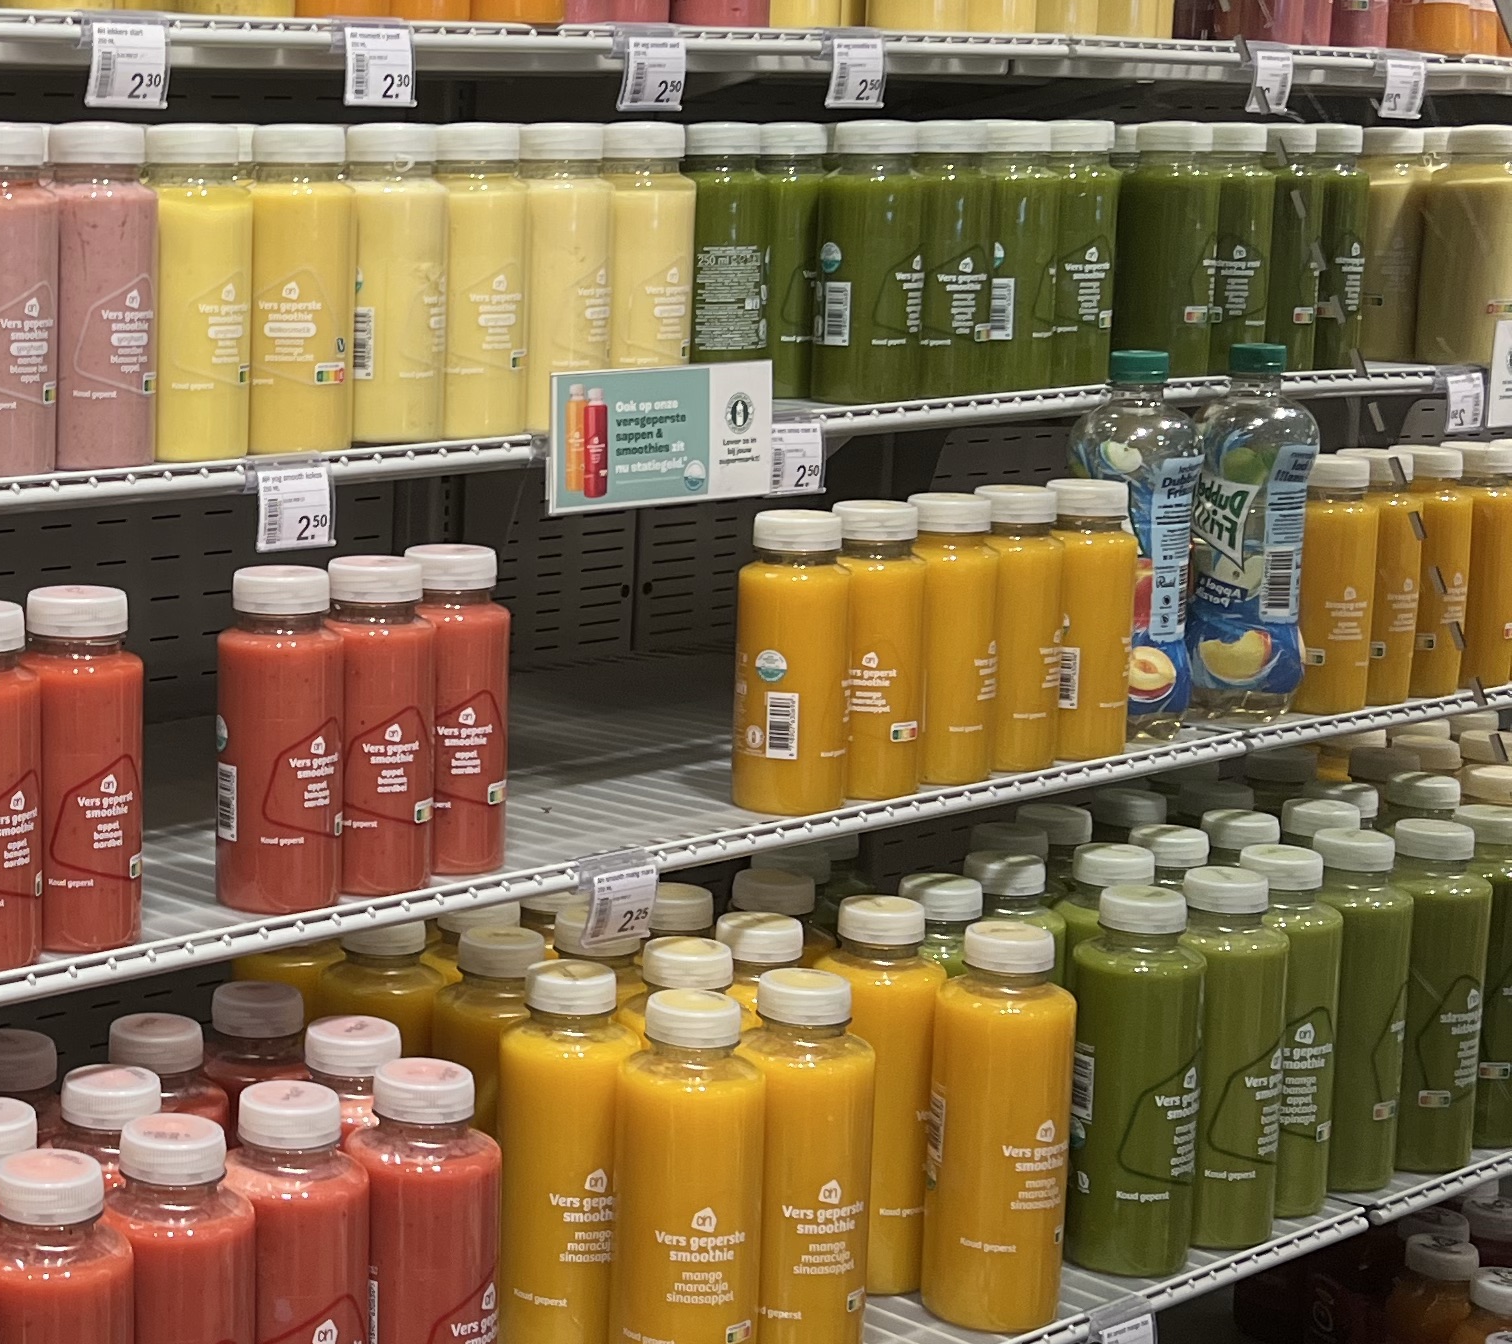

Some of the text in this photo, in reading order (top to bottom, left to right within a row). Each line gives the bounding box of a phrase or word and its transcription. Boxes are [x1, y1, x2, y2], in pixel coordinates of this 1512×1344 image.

[127, 72, 161, 99] 2.30
[382, 74, 410, 99] 2.30
[654, 80, 682, 103] 2.50
[794, 465, 820, 488] 2.50
[296, 515, 327, 541] 2.50
[617, 907, 649, 933] 2.25
[654, 1230, 746, 1251] Vers geperste
[669, 1249, 735, 1263] smoothie
[674, 1280, 729, 1294] maracuja
[681, 1271, 723, 1284] mango
[666, 1290, 734, 1306] sinaasappel
